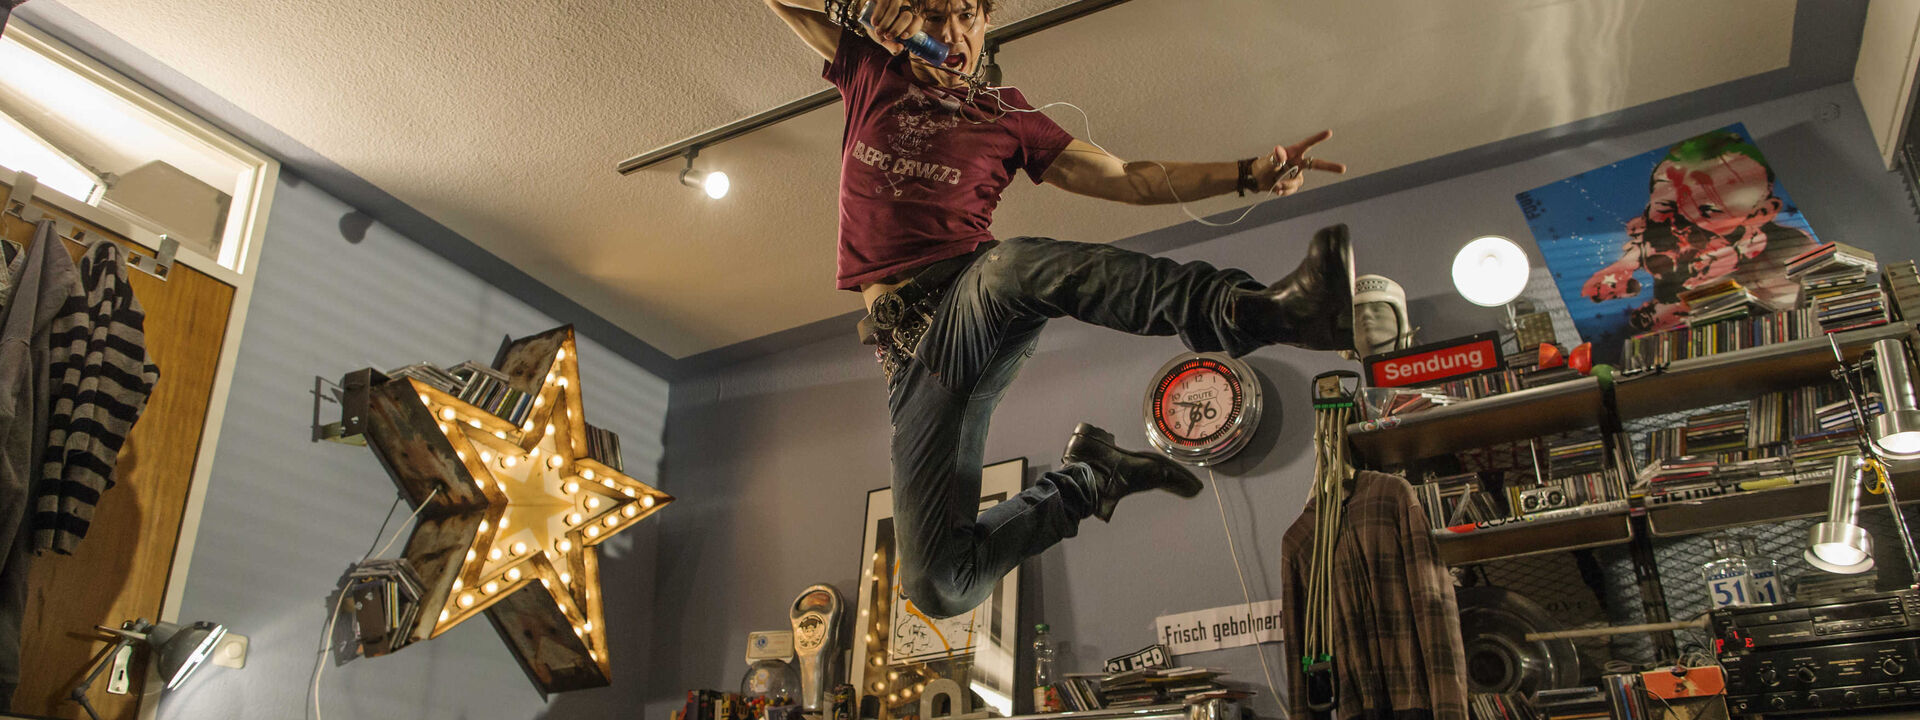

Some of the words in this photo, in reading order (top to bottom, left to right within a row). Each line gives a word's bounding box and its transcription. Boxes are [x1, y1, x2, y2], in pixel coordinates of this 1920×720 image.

[1384, 350, 1483, 380] Sendung
[1188, 391, 1213, 400] ROUTE
[1190, 401, 1217, 422] 66
[1713, 579, 1746, 605] 51
[1165, 620, 1207, 646] Frisch
[1213, 611, 1283, 642] gebohnert
